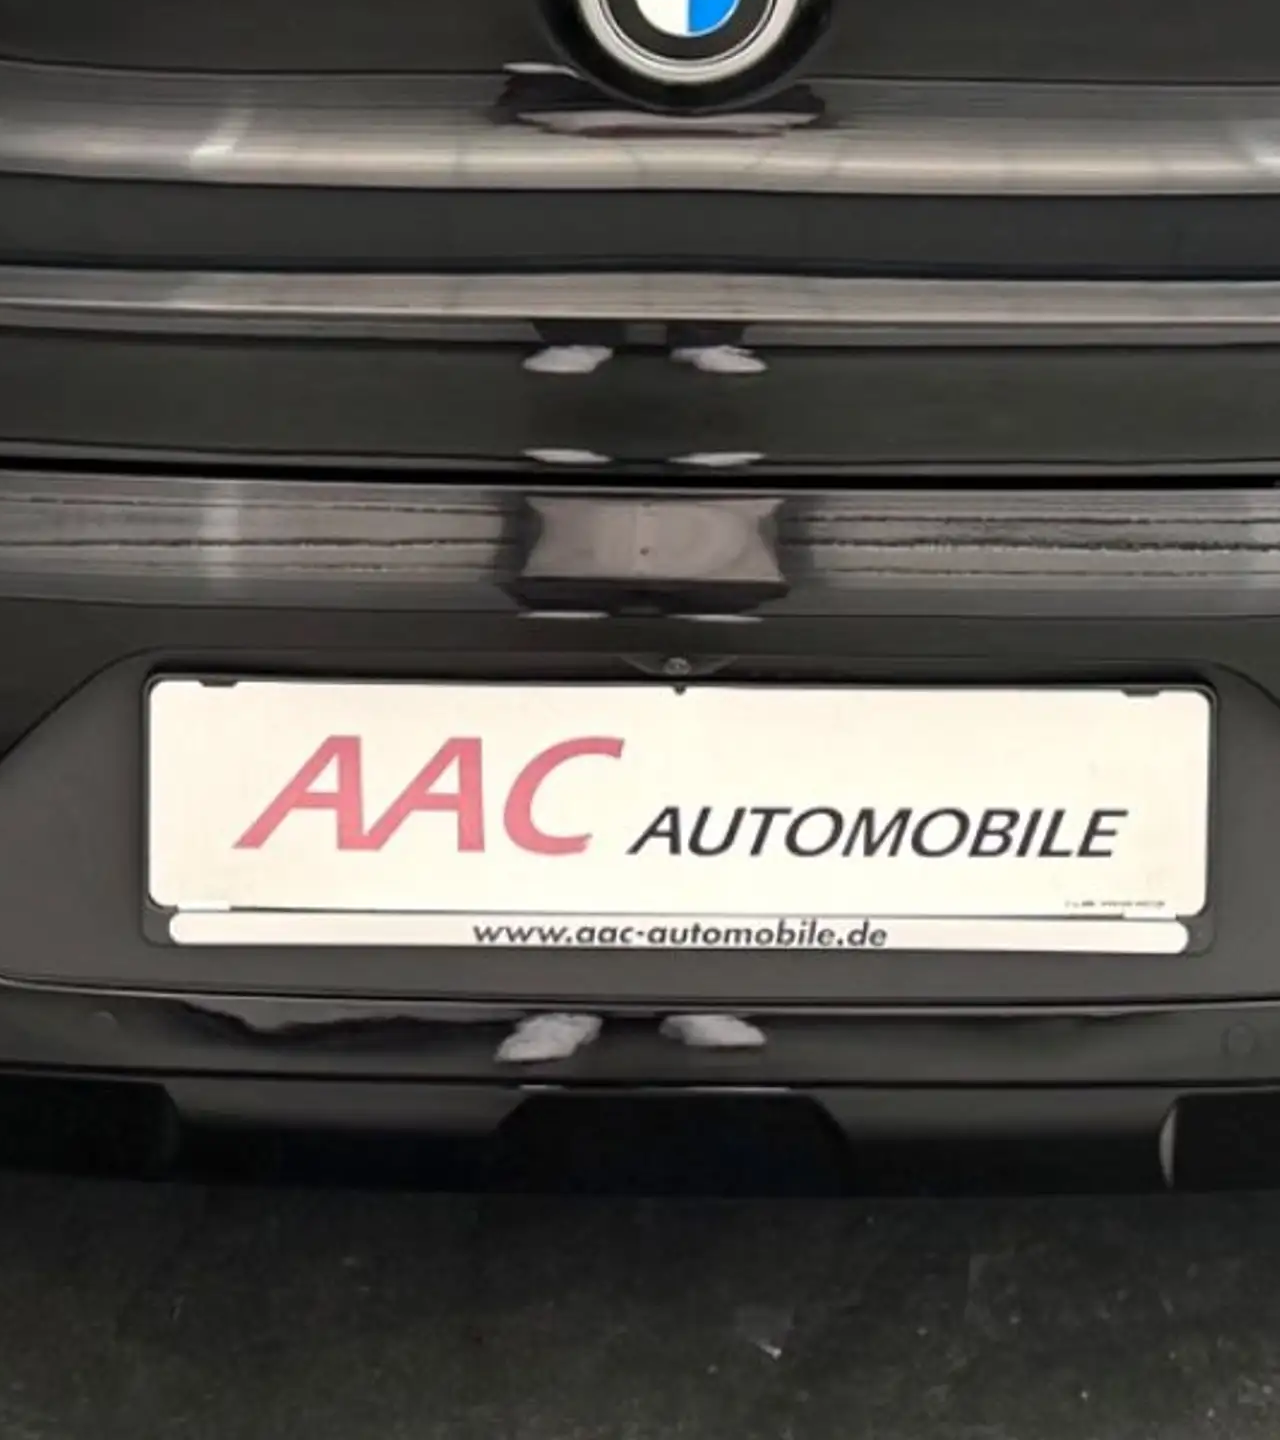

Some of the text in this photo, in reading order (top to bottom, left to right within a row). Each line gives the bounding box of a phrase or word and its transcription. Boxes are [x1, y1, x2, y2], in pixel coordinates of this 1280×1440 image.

[234, 735, 1128, 859] AAC AUTOMOBILE
[472, 918, 889, 948] www.aac-automobile.de
